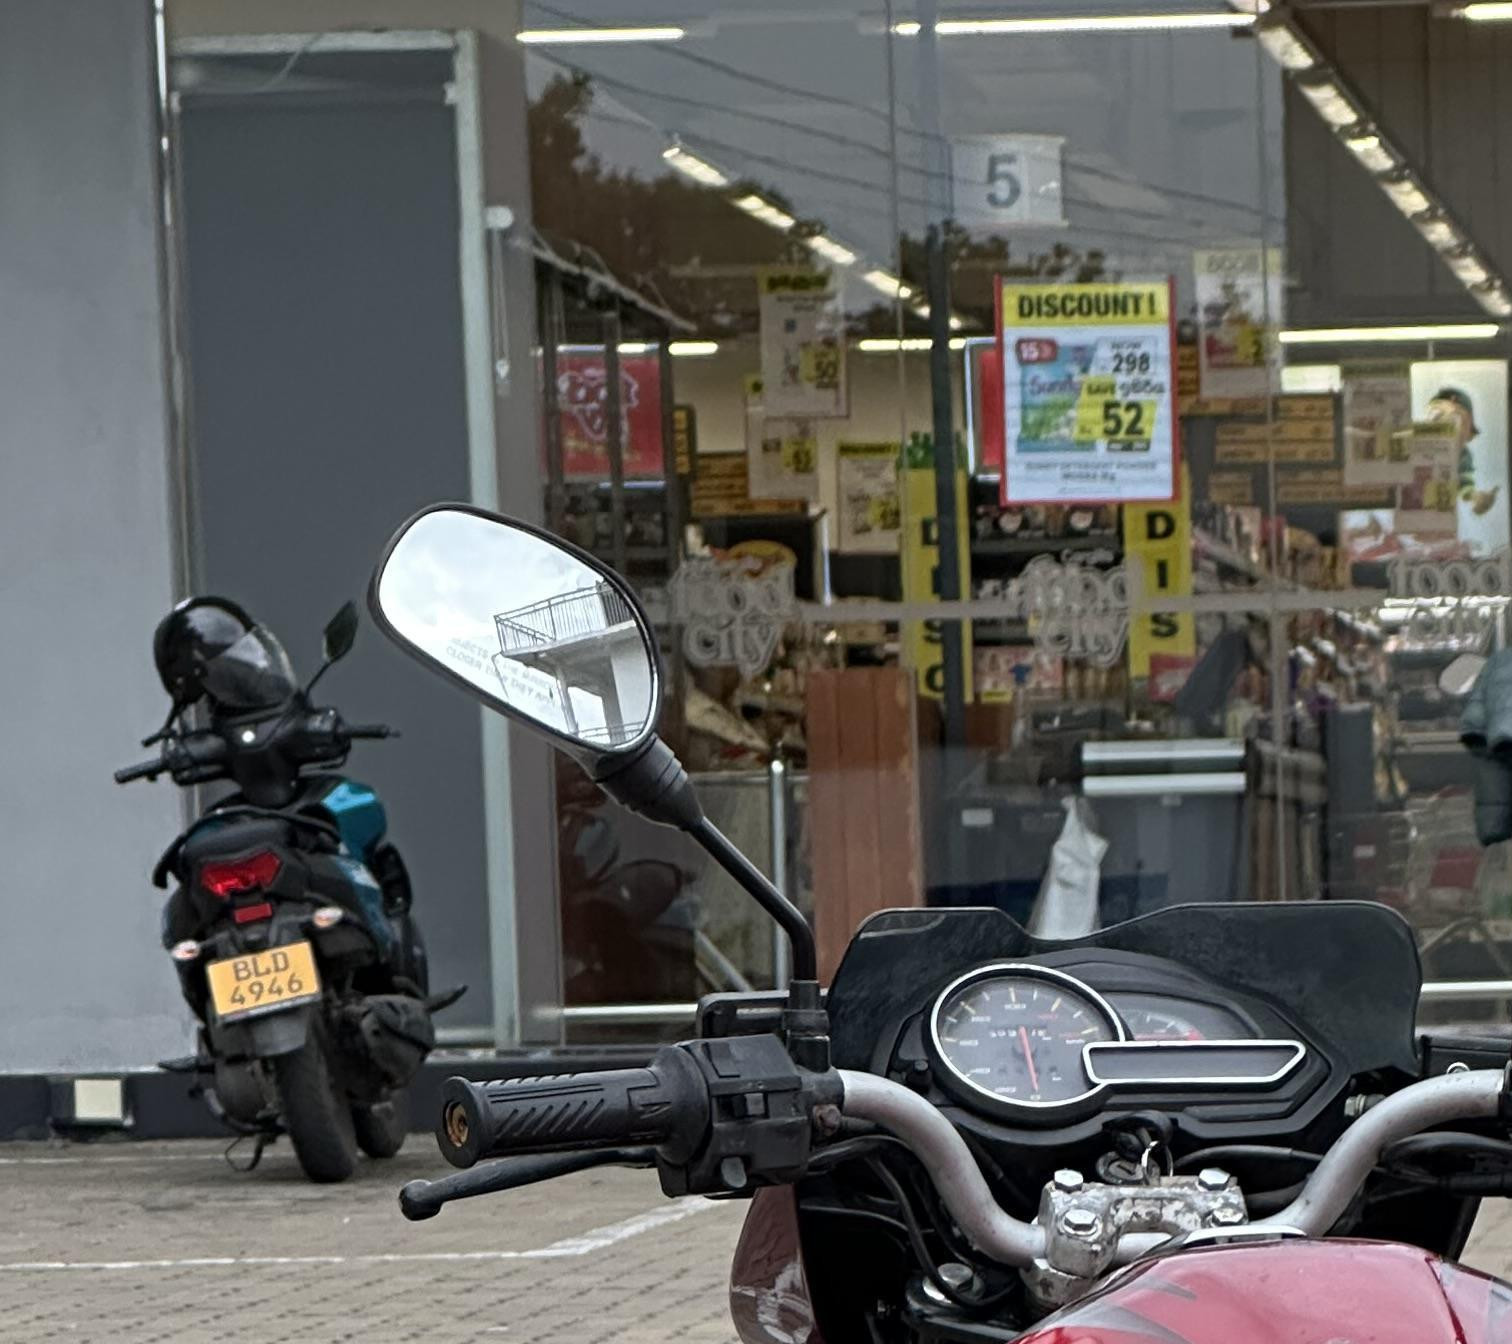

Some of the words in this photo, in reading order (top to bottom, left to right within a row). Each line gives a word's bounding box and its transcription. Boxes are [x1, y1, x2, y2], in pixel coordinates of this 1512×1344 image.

[986, 154, 1020, 208] 5
[1112, 352, 1150, 374] 298
[1103, 401, 1144, 436] 52
[232, 950, 290, 982] BLD
[230, 972, 304, 1005] 4946
